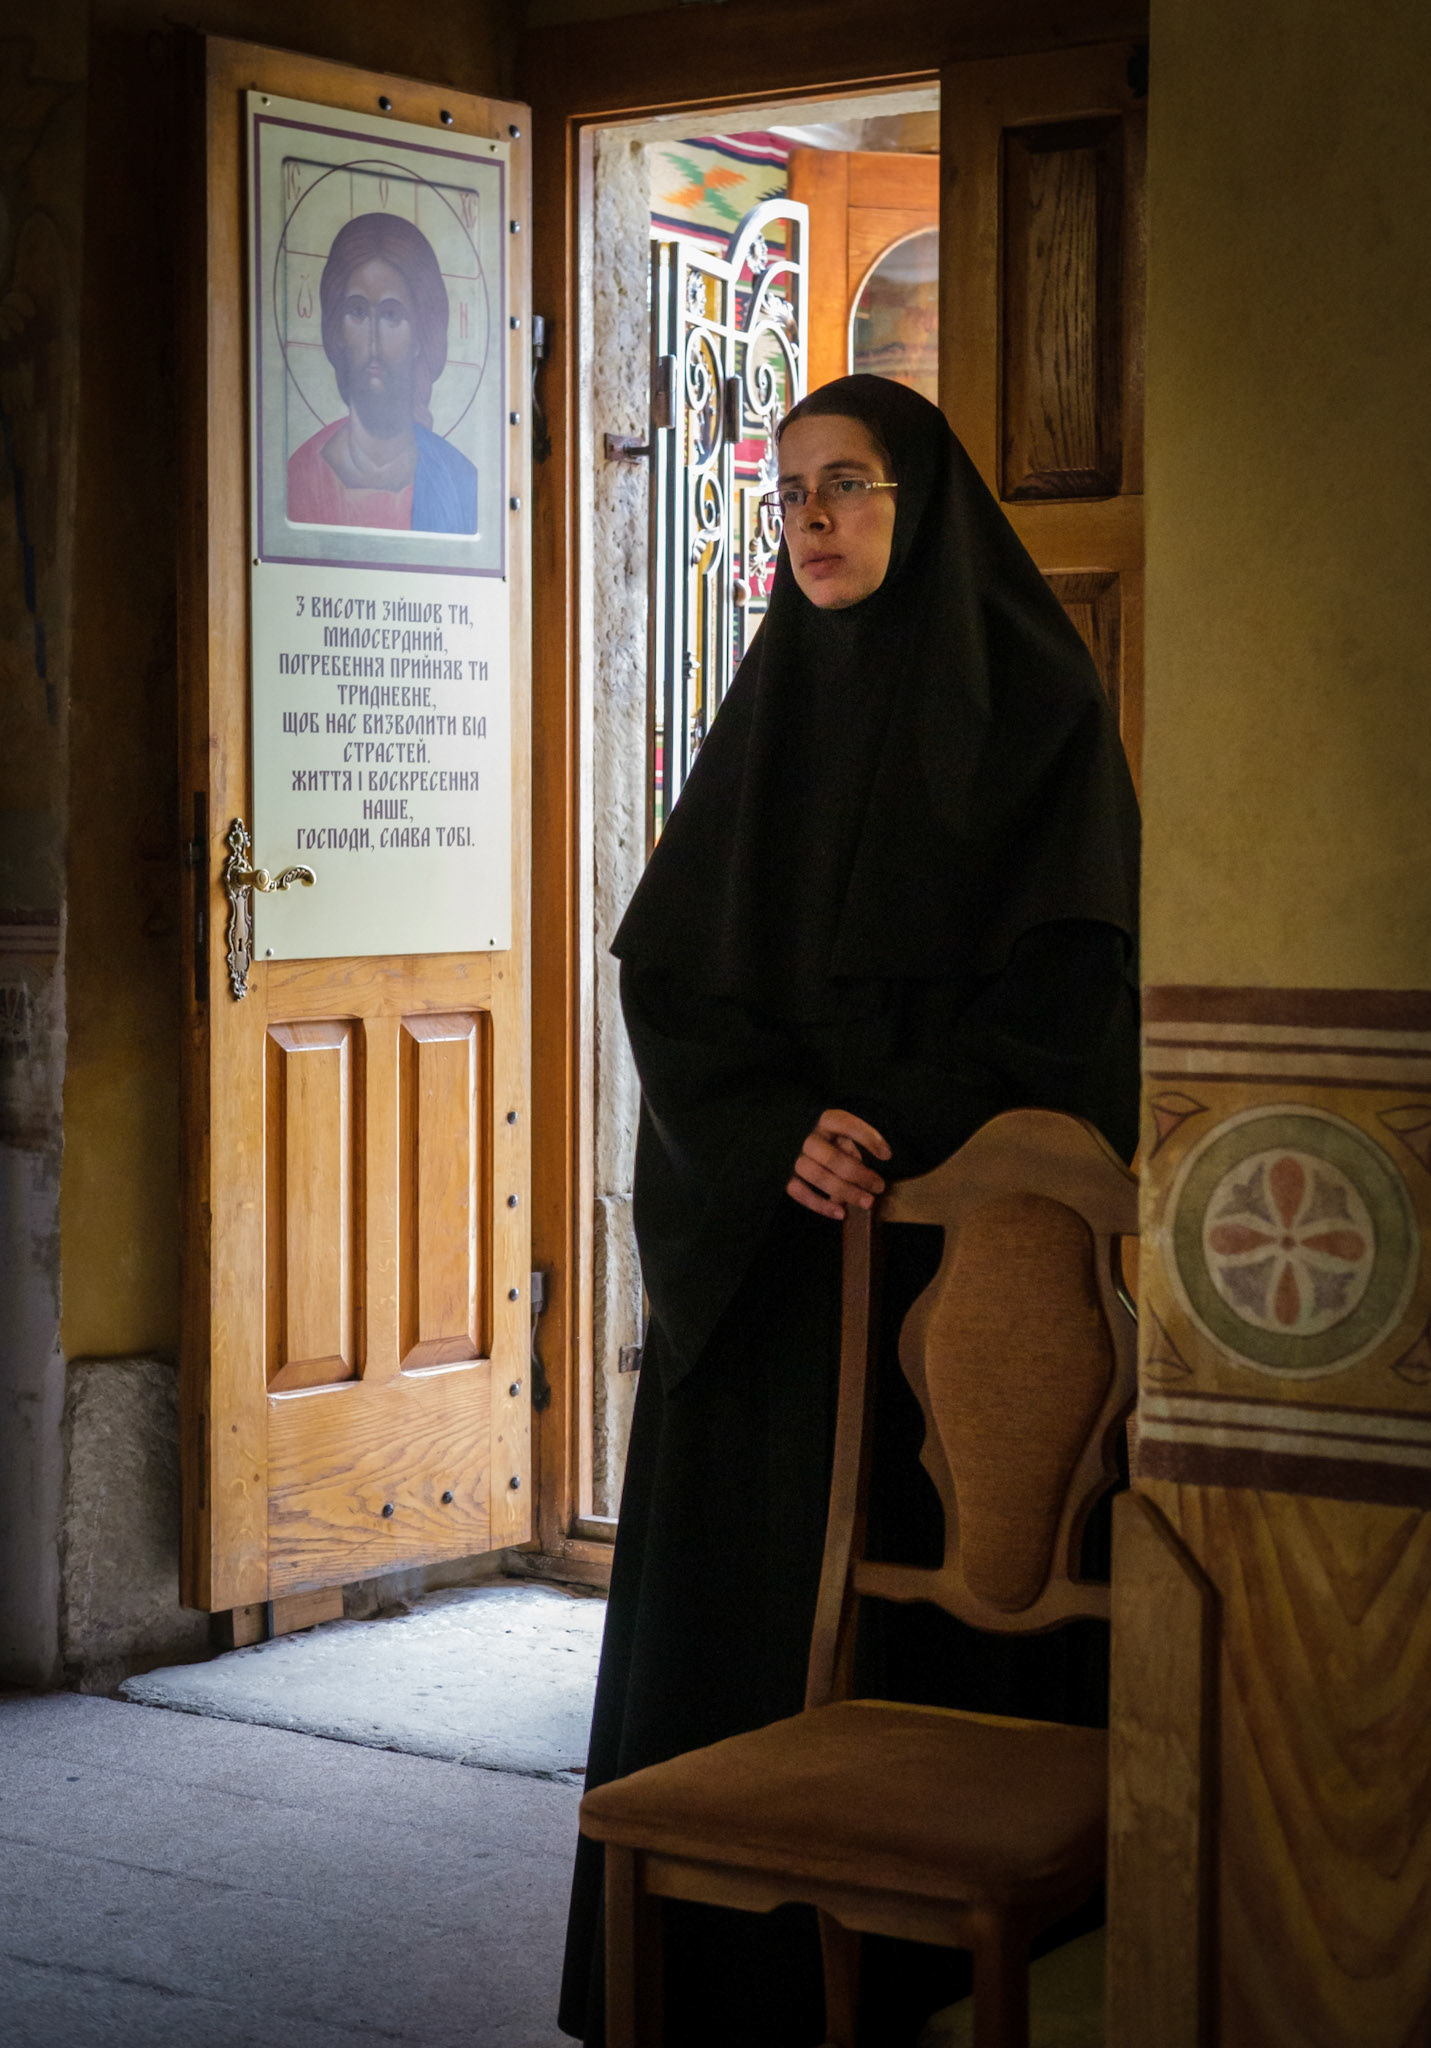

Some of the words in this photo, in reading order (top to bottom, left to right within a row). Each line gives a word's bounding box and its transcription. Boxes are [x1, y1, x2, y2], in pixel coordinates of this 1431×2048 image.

[296, 595, 305, 617] З
[311, 596, 376, 620] ВИСОТИ
[382, 597, 442, 624] ЗІЙШОВ
[448, 604, 474, 629] ТИ,
[324, 626, 448, 655] МИЛОСЕРДНИЙ,
[279, 653, 385, 678] ПОГРЕБЕННЯ
[390, 655, 463, 680] ПРИЙНЯВ
[468, 660, 489, 681] ТИ
[337, 684, 437, 711] ТРИДНЕВНЕ,
[282, 711, 320, 736] ЩОБ
[326, 713, 357, 734] НАС
[363, 714, 457, 736] ВИЗВОЛИТИ
[462, 716, 487, 739] ВІД
[343, 739, 431, 764] СТРАСТЕЙ.
[292, 770, 352, 791] ЖИТТЯ
[358, 770, 363, 791] І
[368, 771, 479, 792] ВОСКРЕСЕННЯ
[363, 798, 414, 823] НАШЕ,
[297, 828, 375, 852] ГОСПОДИ,
[380, 827, 431, 848] СЛАВА
[436, 827, 475, 848] ТОБІ.
